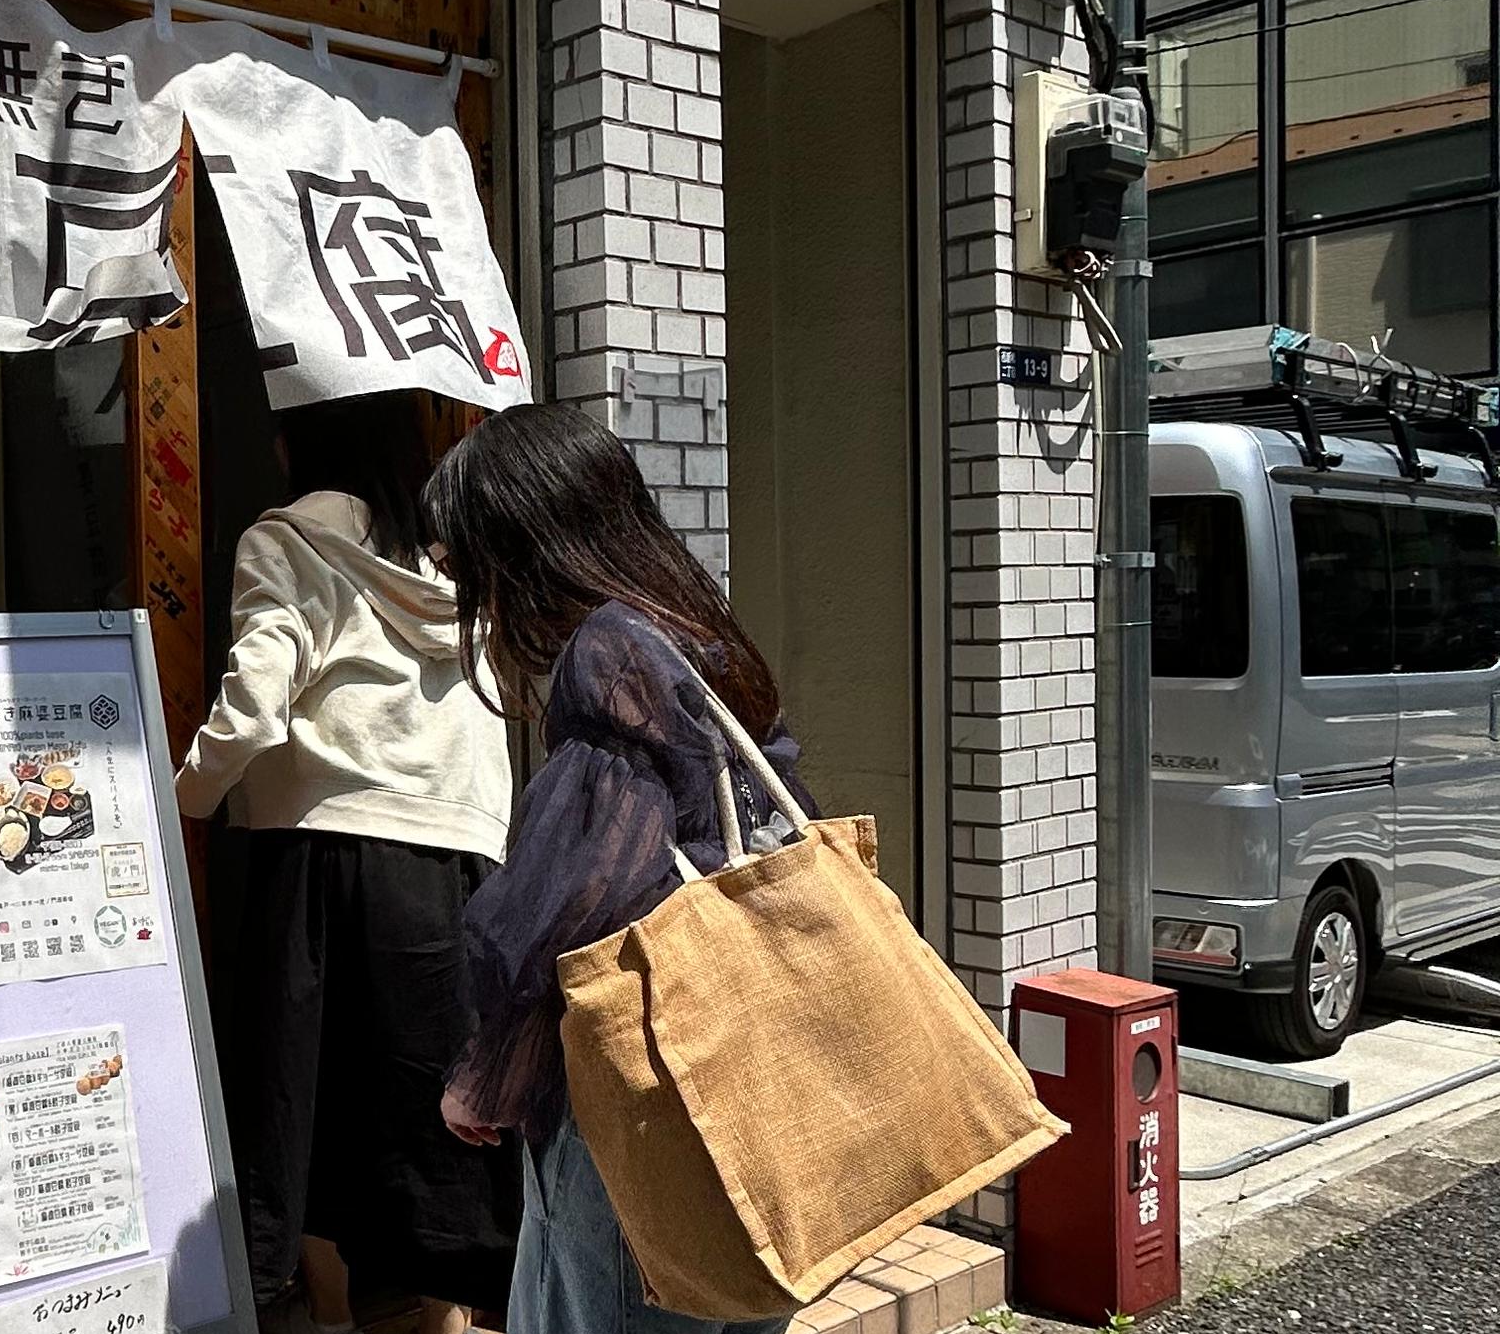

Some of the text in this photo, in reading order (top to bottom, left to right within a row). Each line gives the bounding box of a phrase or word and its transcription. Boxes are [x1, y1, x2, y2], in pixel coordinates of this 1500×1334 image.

[1024, 357, 1049, 378] 13-9
[1137, 1109, 1161, 1227] 消火器
[33, 1283, 132, 1322] おつまみメニュー
